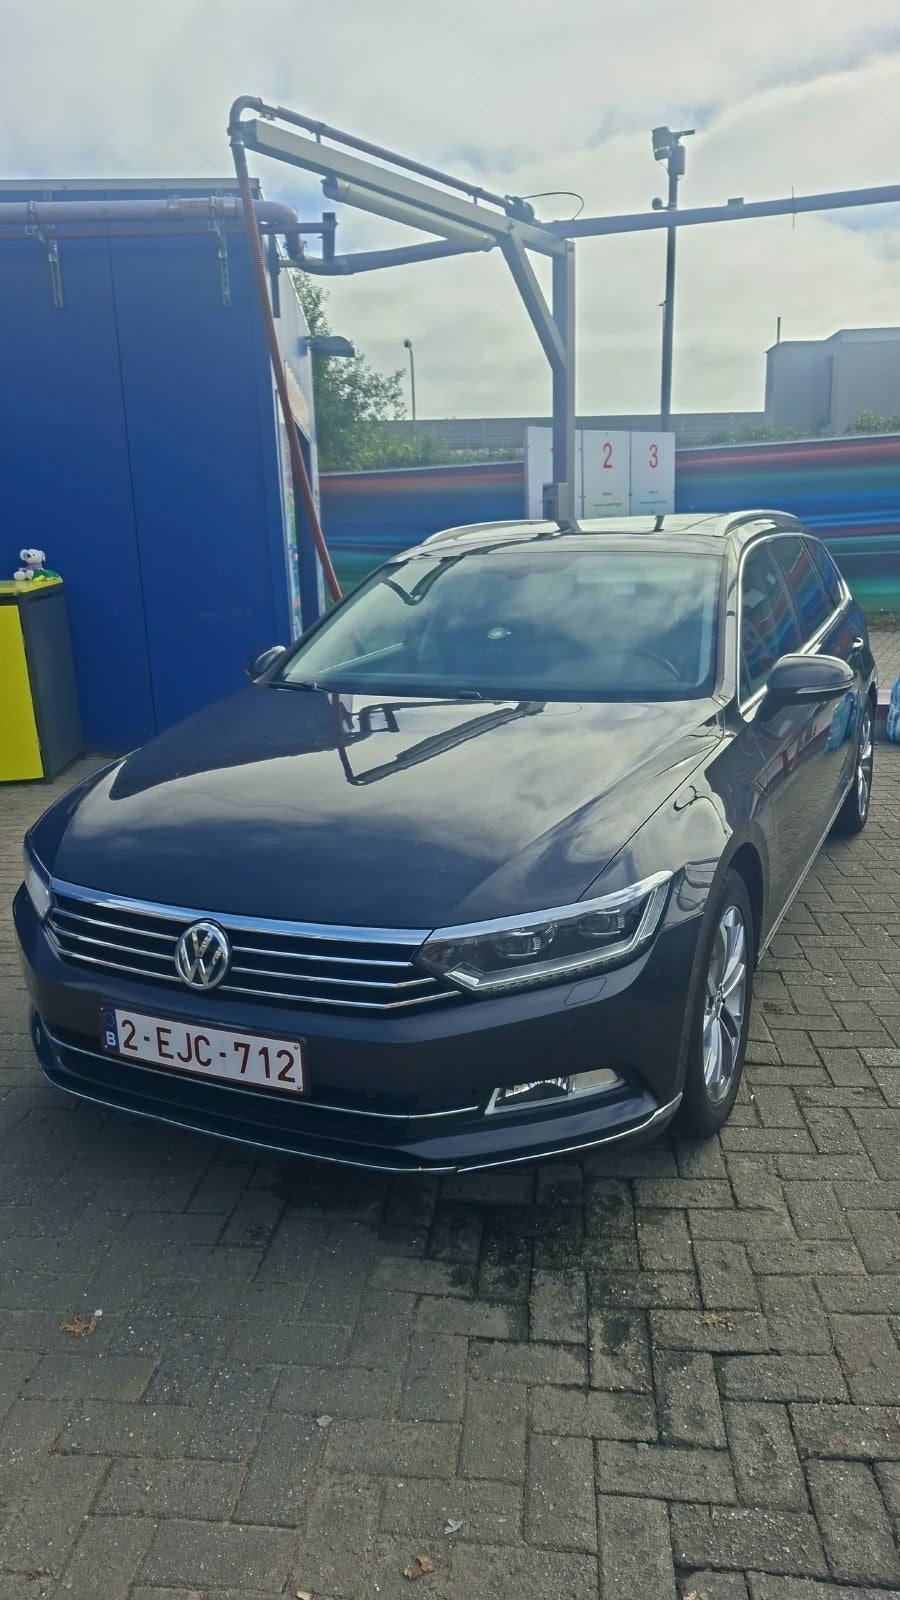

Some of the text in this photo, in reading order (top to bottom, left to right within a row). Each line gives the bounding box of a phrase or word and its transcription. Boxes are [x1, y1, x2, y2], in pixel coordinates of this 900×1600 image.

[603, 442, 613, 469] 2
[649, 443, 659, 469] 3
[106, 1030, 117, 1046] B
[121, 1019, 296, 1083] 2-EJC-712
